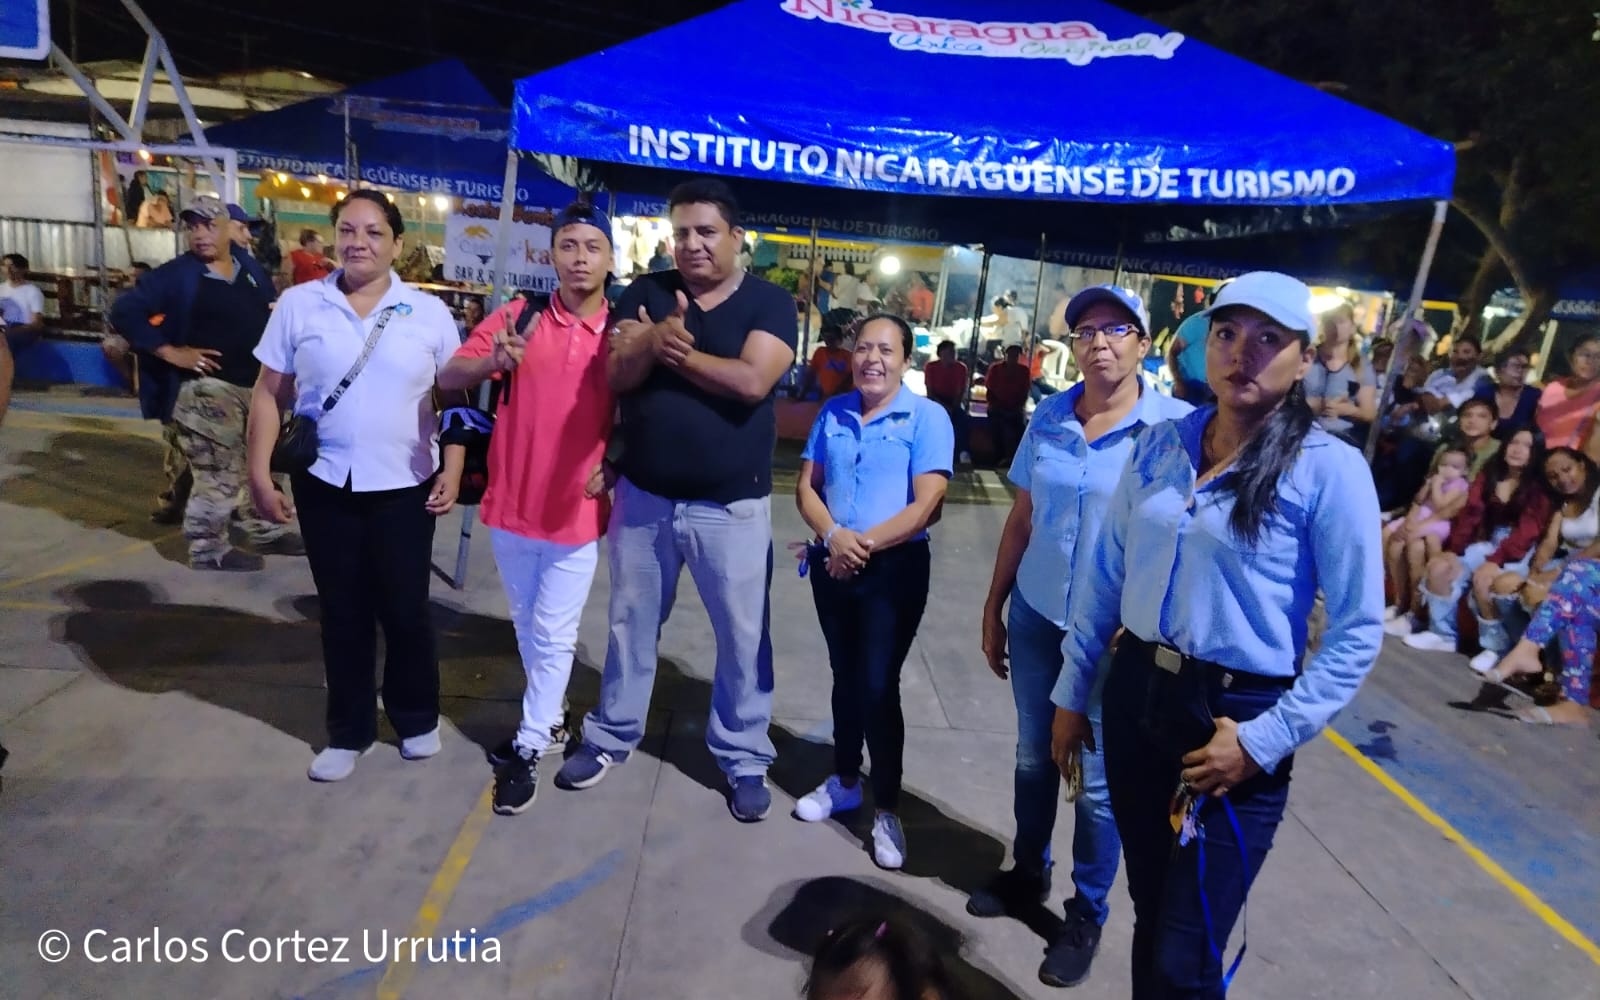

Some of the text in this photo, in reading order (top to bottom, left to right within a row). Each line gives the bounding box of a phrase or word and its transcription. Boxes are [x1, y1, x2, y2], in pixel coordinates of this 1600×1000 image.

[789, 0, 1098, 45] Nicaragua
[628, 124, 1356, 199] INSTITUTO NICARAGÜENSE DE TURISMO
[455, 179, 529, 202] TURISO
[867, 222, 940, 241] TURISMO
[488, 271, 557, 292] RSTAURANTE
